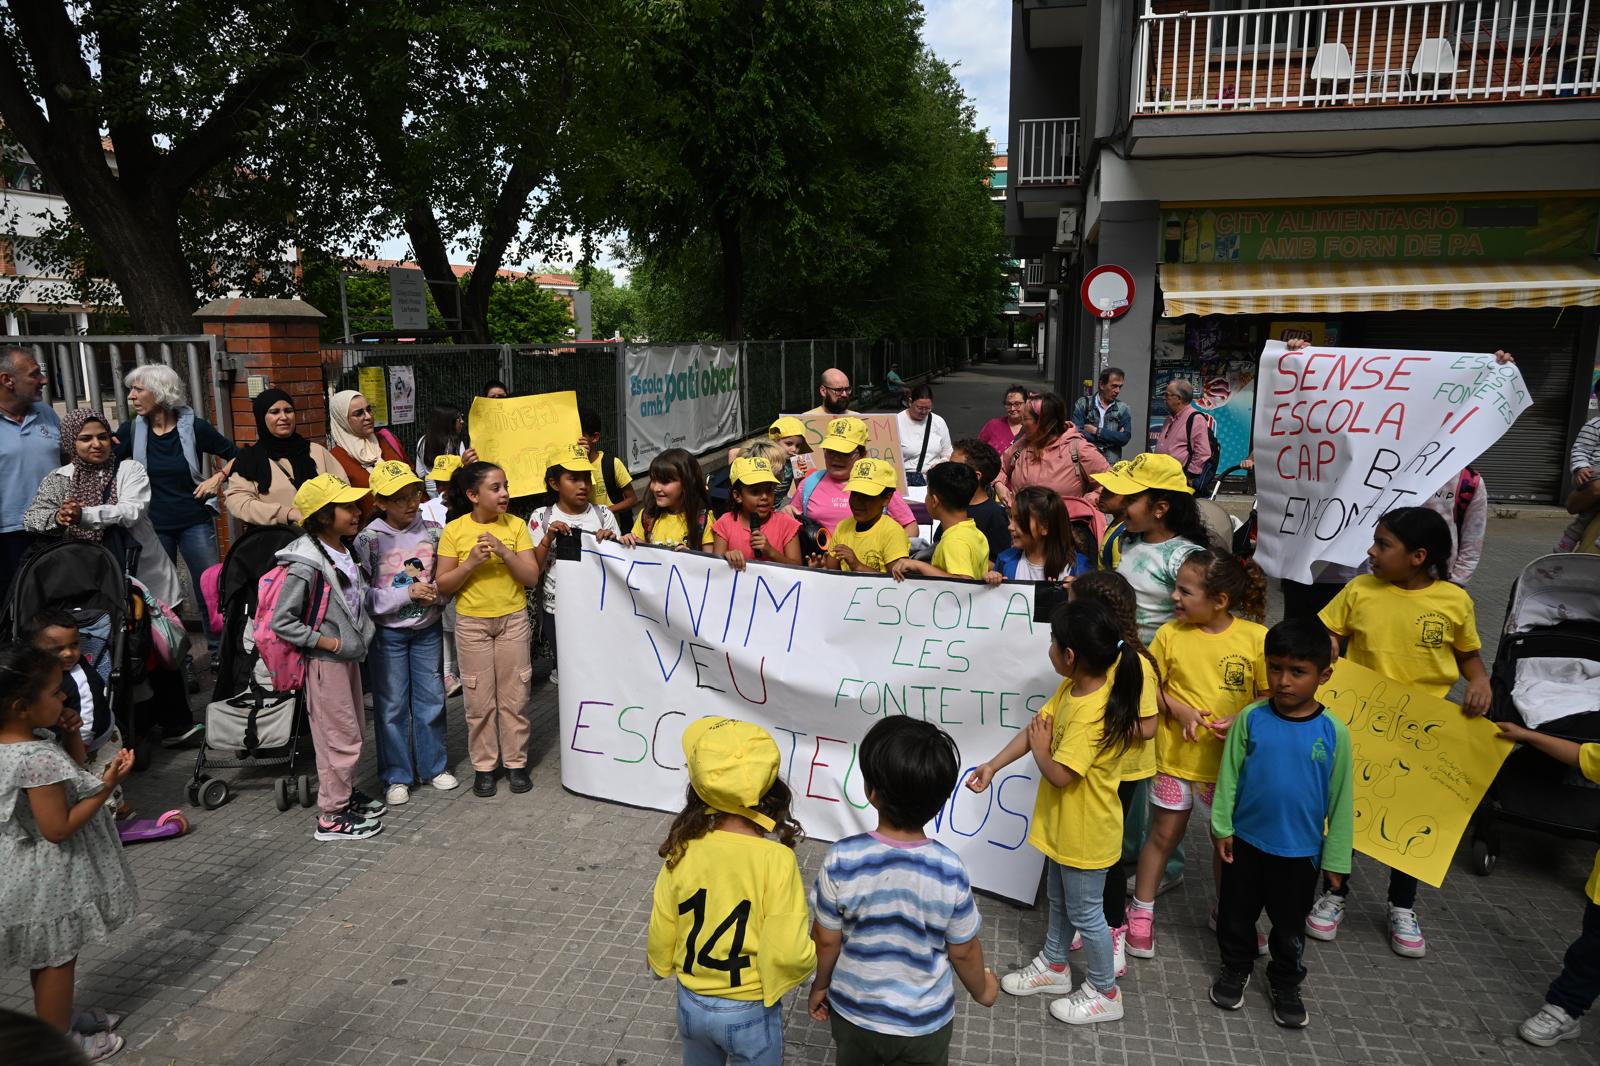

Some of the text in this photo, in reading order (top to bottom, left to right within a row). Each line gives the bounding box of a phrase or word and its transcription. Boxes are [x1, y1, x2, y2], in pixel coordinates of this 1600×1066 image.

[1215, 202, 1457, 234] CITY ALIMENTACIÓ
[1257, 233, 1485, 260] AMB FORN DE PA
[630, 373, 664, 396] Escola
[664, 358, 738, 414] pati obert
[1274, 352, 1431, 395] SENSE
[640, 395, 663, 417] amb
[1270, 399, 1405, 441] ESCOLA
[579, 549, 802, 653] TENIM
[843, 587, 1033, 635] ESCOLA
[645, 630, 768, 705] VEU
[891, 636, 970, 672] LES
[678, 887, 752, 988] 14
